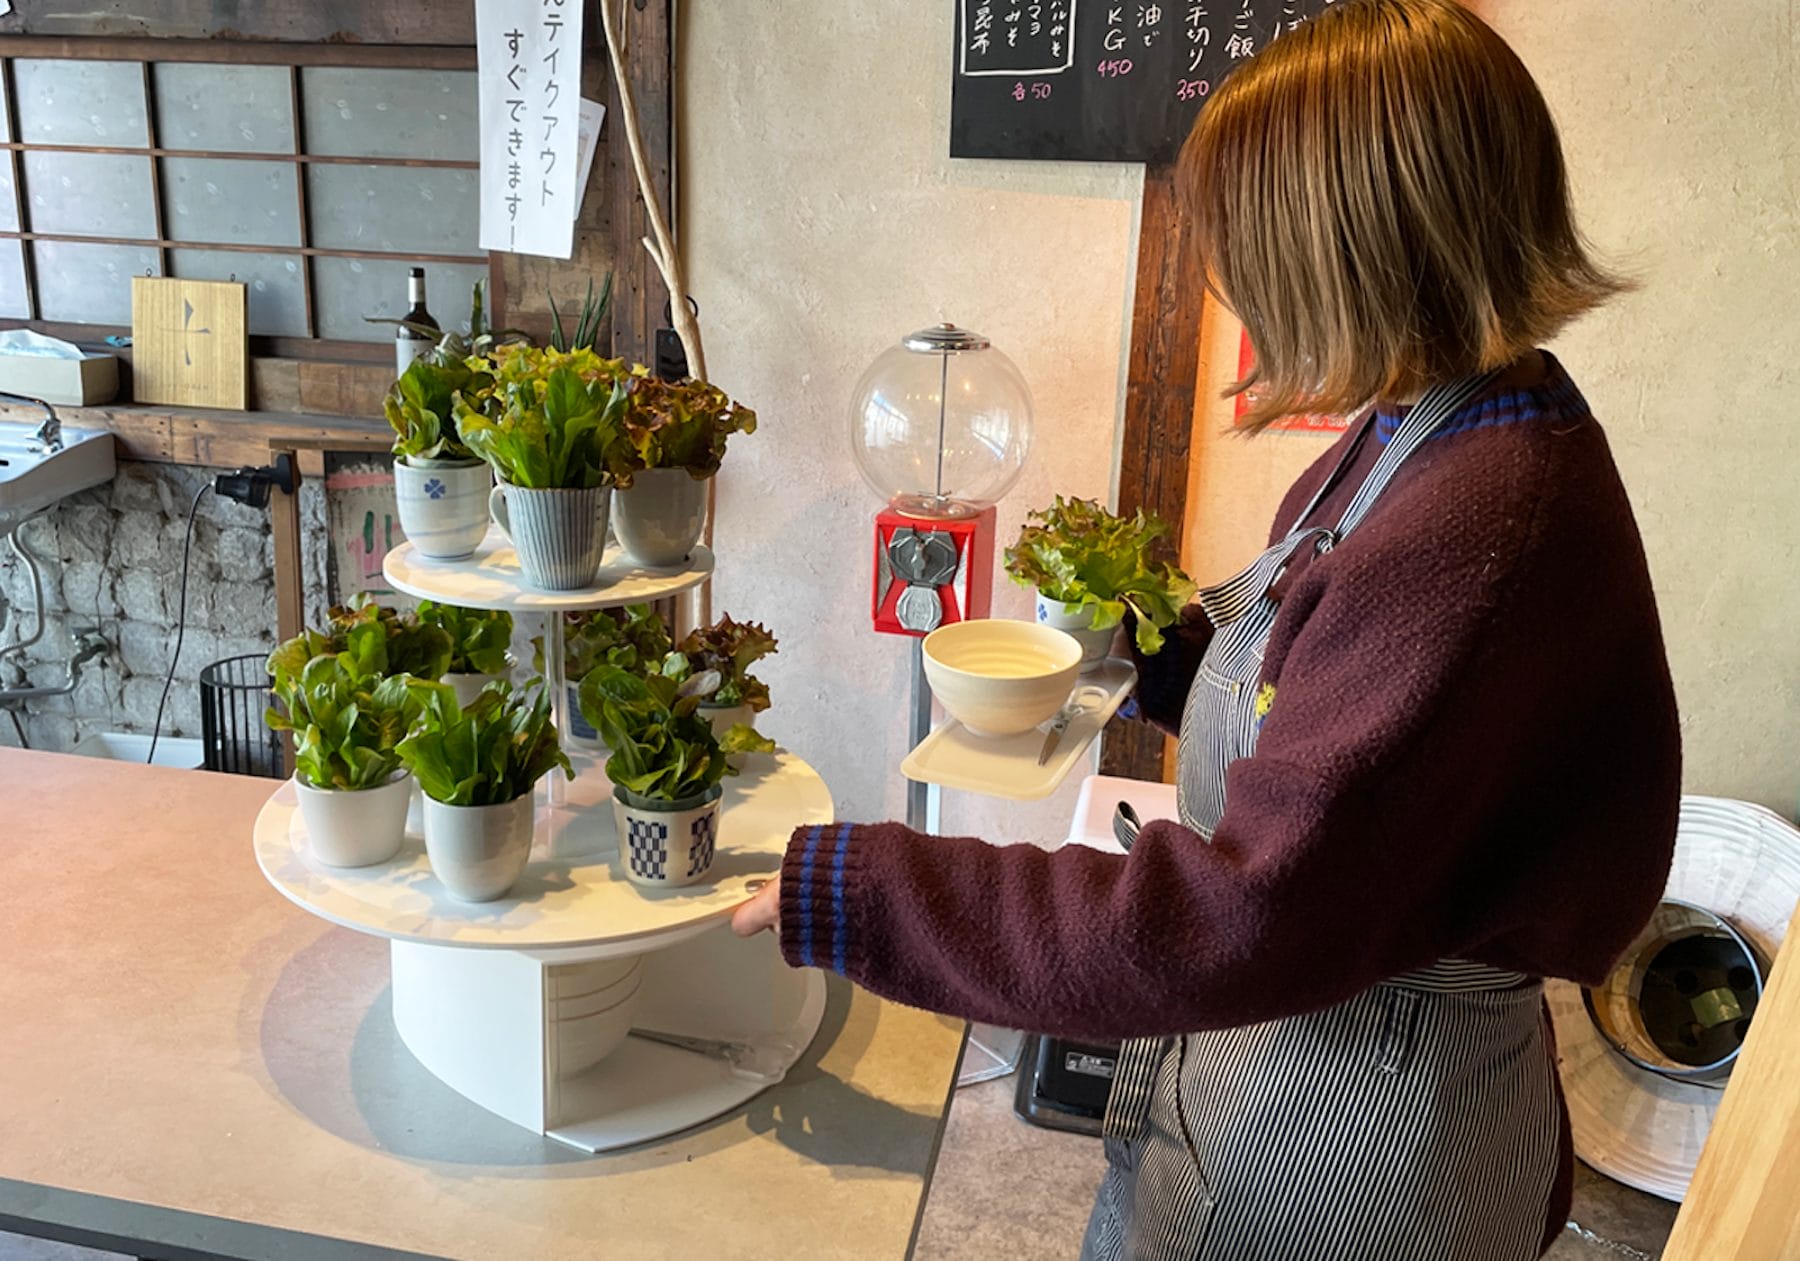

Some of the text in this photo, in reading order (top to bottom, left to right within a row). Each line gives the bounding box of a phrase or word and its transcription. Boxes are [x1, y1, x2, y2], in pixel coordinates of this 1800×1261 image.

[969, 0, 994, 55] 昆布
[1004, 0, 1021, 47] みそ
[1028, 0, 1042, 36] マヨ
[1103, 0, 1128, 51] KG
[1136, 4, 1162, 47] 油で
[1223, 0, 1256, 60] ご飯
[1031, 82, 1052, 99] 50
[1097, 59, 1134, 78] 450
[1176, 79, 1210, 101] 350
[540, 0, 565, 207] テイクアウト
